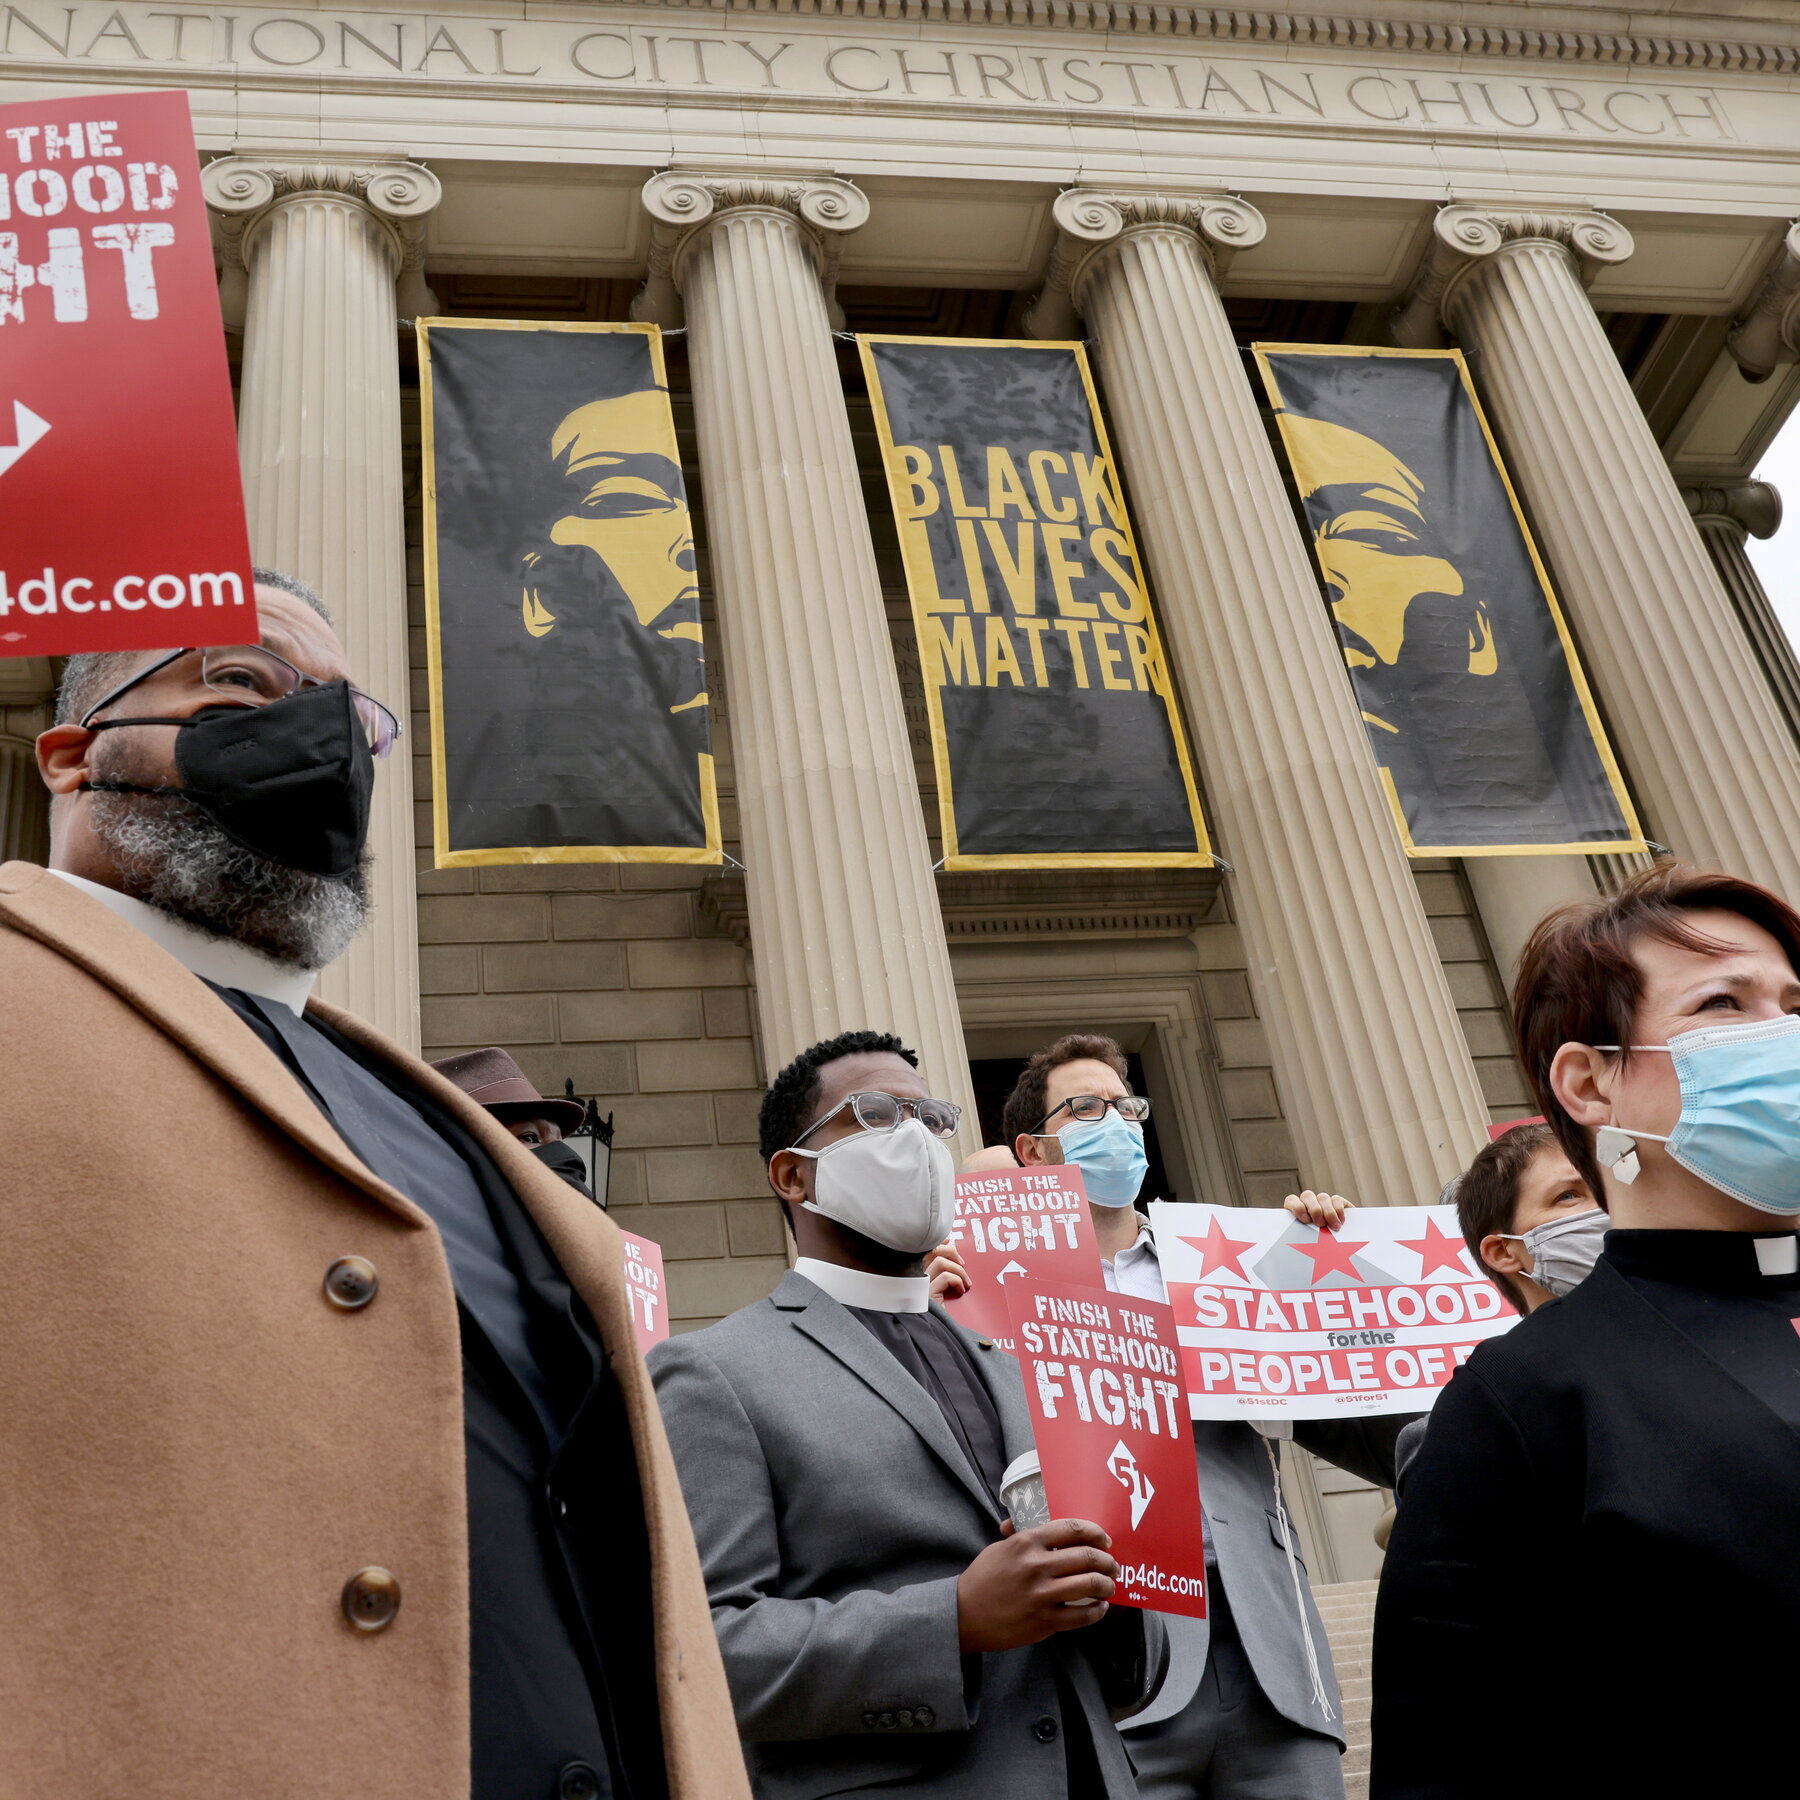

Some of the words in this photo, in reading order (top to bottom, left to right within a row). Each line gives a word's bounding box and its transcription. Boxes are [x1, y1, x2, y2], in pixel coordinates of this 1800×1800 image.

[3, 5, 542, 77] NATIONAL
[569, 32, 795, 88] CITY
[821, 45, 1326, 118] CHRISTIAN
[1346, 75, 1735, 140] CHURCH
[5, 120, 123, 163] THE
[0, 161, 179, 221] OOD
[890, 445, 1128, 532] BLACK
[904, 516, 1148, 625] LIVES
[924, 615, 1168, 698] MATTER
[954, 1190, 1081, 1216] TATEHOOD
[955, 1177, 1012, 1196] INISH
[1021, 1175, 1061, 1190] THE
[948, 1213, 1081, 1253] FIGHT
[1034, 1294, 1111, 1330] FINISH
[1119, 1308, 1159, 1340] THE
[1193, 1283, 1502, 1331] STATEHOOD
[1021, 1321, 1177, 1377] STATEHOOD
[1327, 1331, 1357, 1348] for
[1360, 1330, 1396, 1346] the
[1199, 1350, 1381, 1394] PEOPLE
[1385, 1347, 1446, 1388] OF
[1033, 1359, 1180, 1440] FIGHT
[1236, 1397, 1288, 1407] @51stDC
[1334, 1393, 1390, 1404] @51for51
